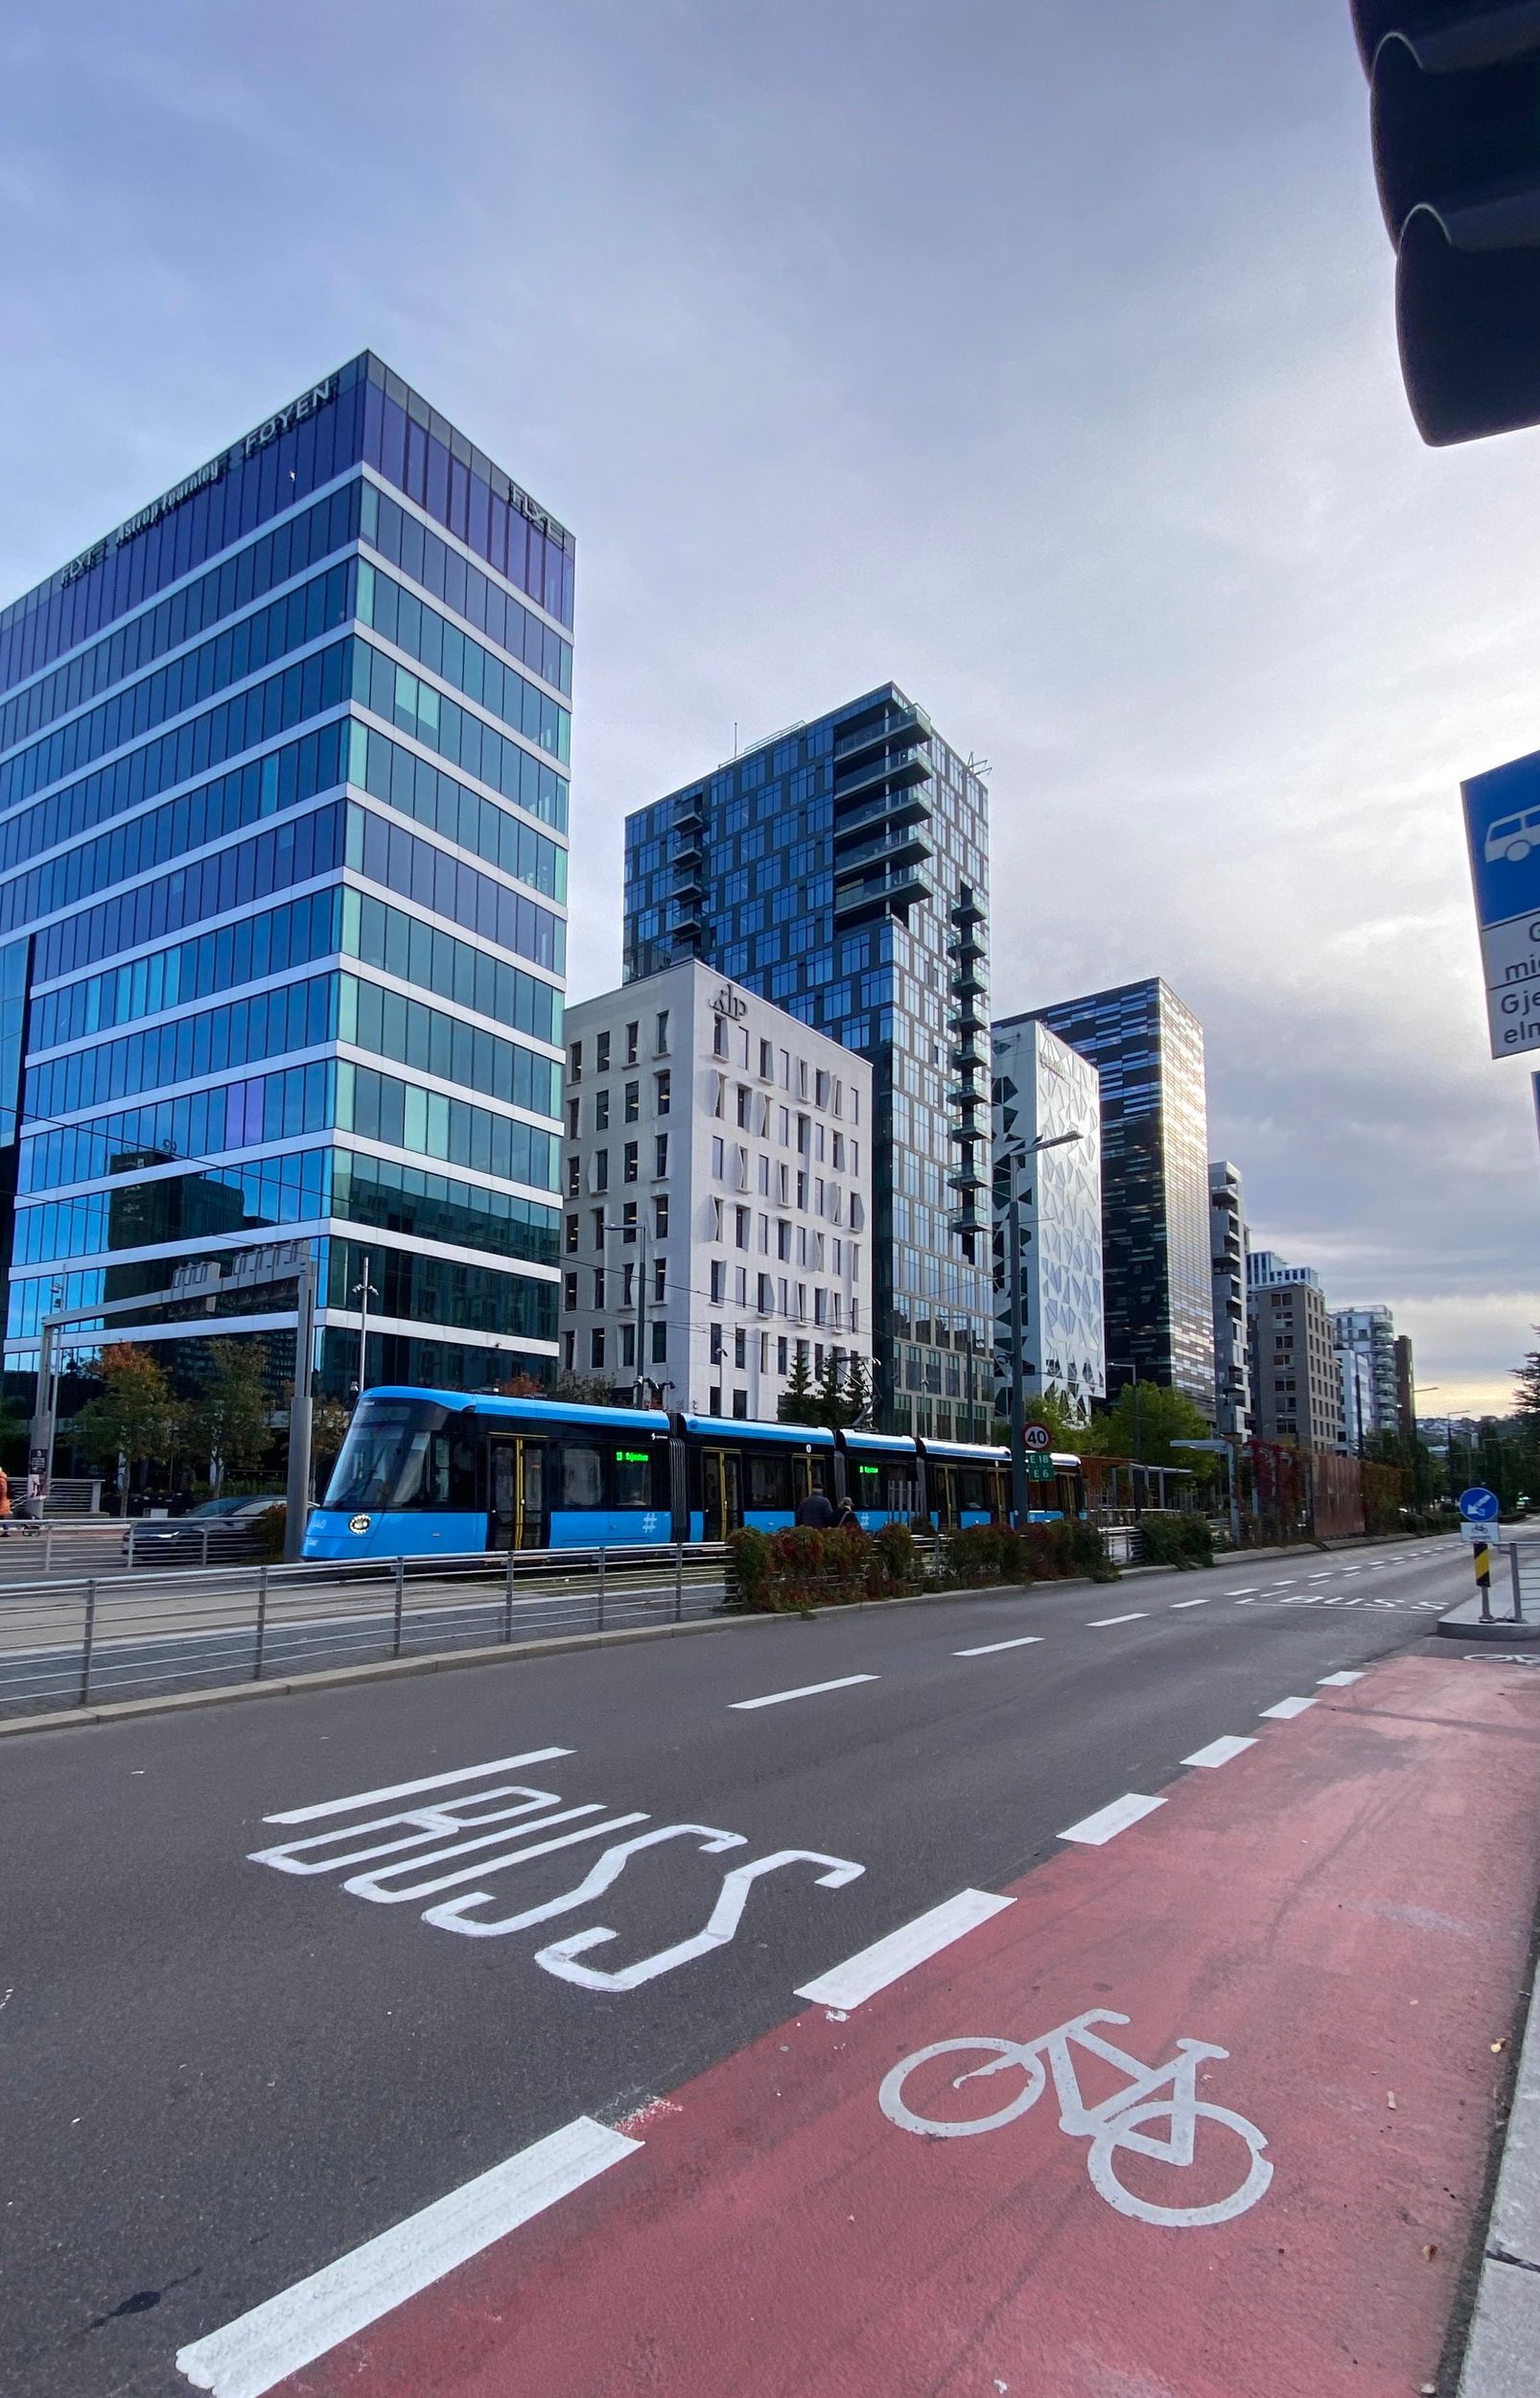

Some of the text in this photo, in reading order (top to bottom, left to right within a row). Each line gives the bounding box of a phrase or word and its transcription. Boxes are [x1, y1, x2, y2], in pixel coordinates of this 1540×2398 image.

[1027, 1430, 1047, 1445] 40
[1030, 1455, 1036, 1464] E
[1034, 1469, 1039, 1478] E
[1279, 1595, 1450, 1610] BUSS
[245, 1785, 867, 1993] BUSS
